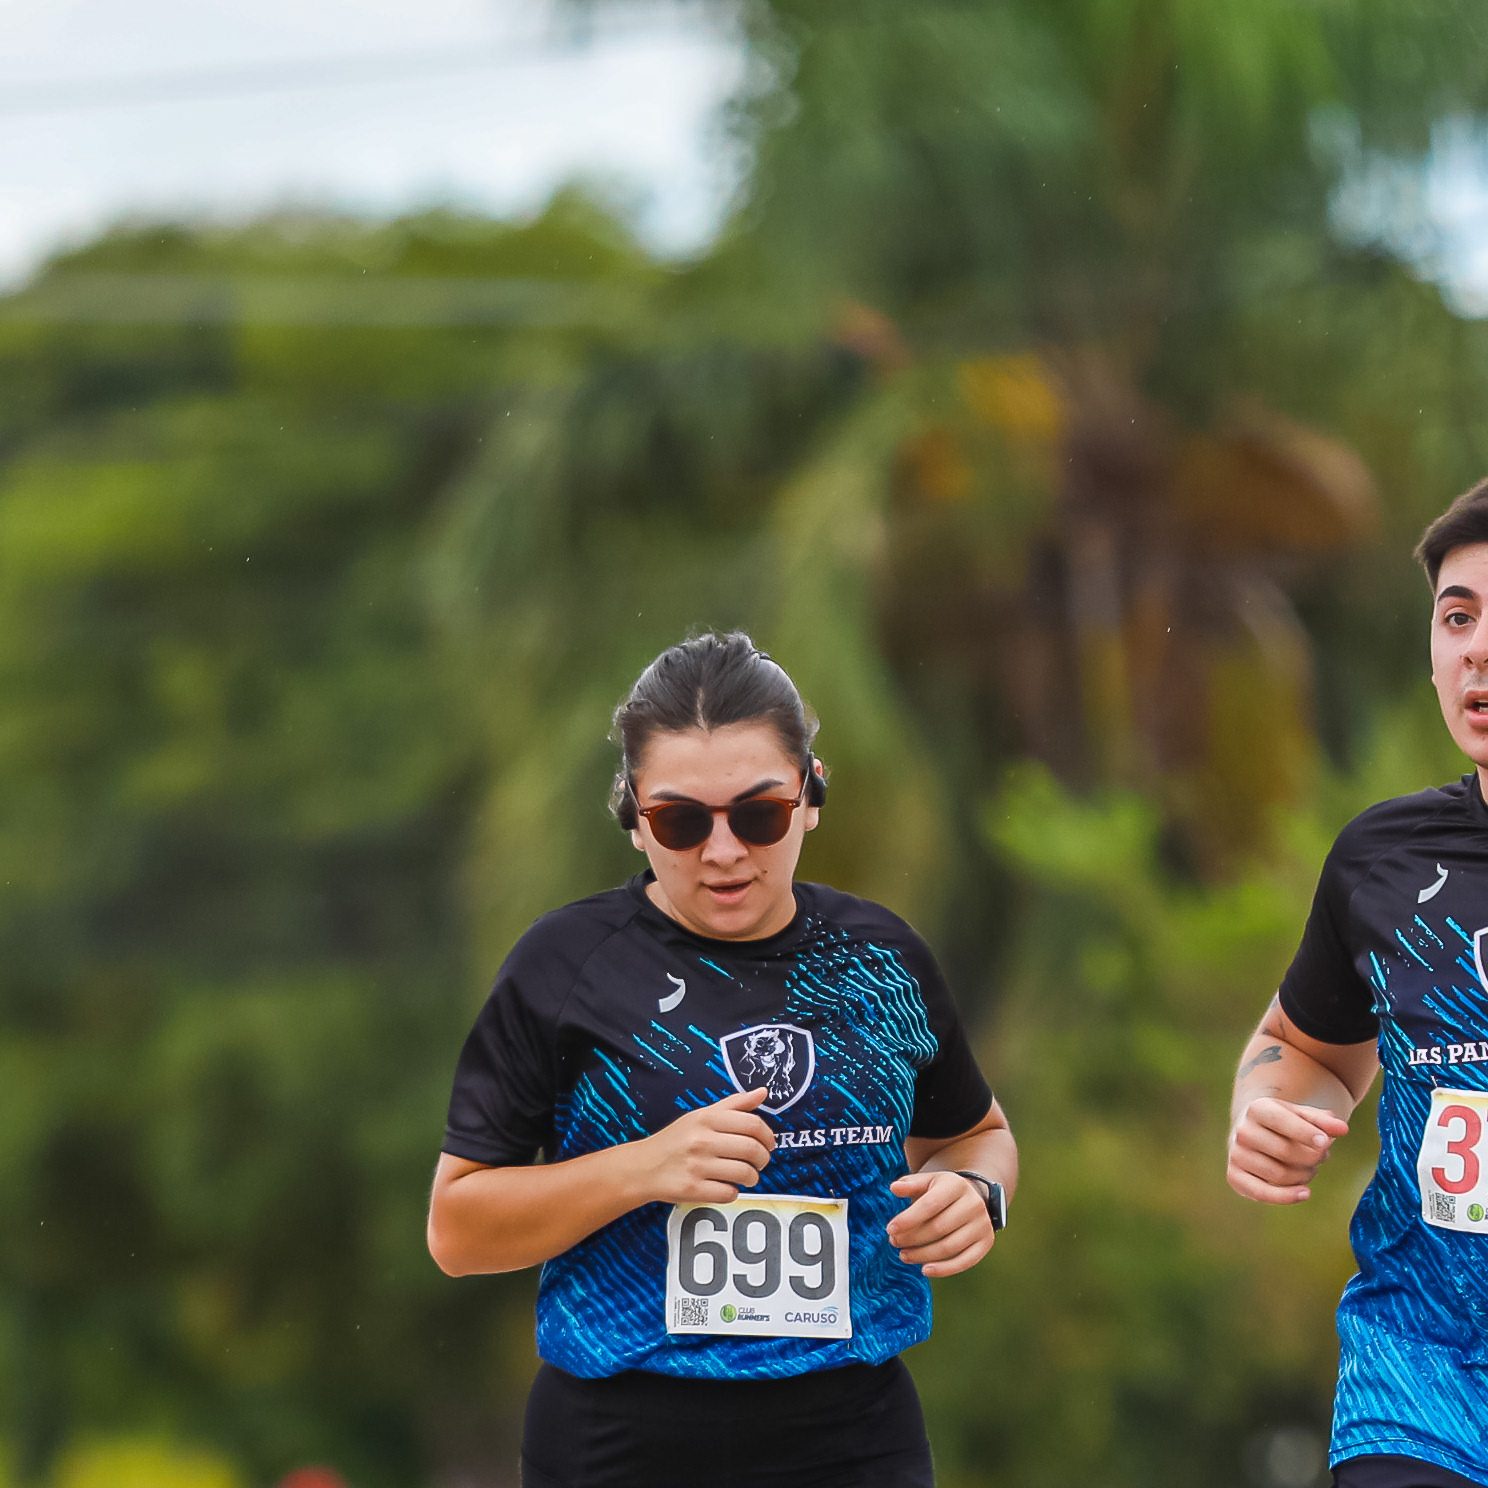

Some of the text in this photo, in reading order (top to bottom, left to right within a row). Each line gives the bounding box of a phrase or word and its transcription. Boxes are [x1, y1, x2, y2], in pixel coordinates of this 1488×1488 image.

[830, 1125, 894, 1146] TEAM
[678, 1206, 836, 1301] 699
[784, 1311, 838, 1325] CARUSO
